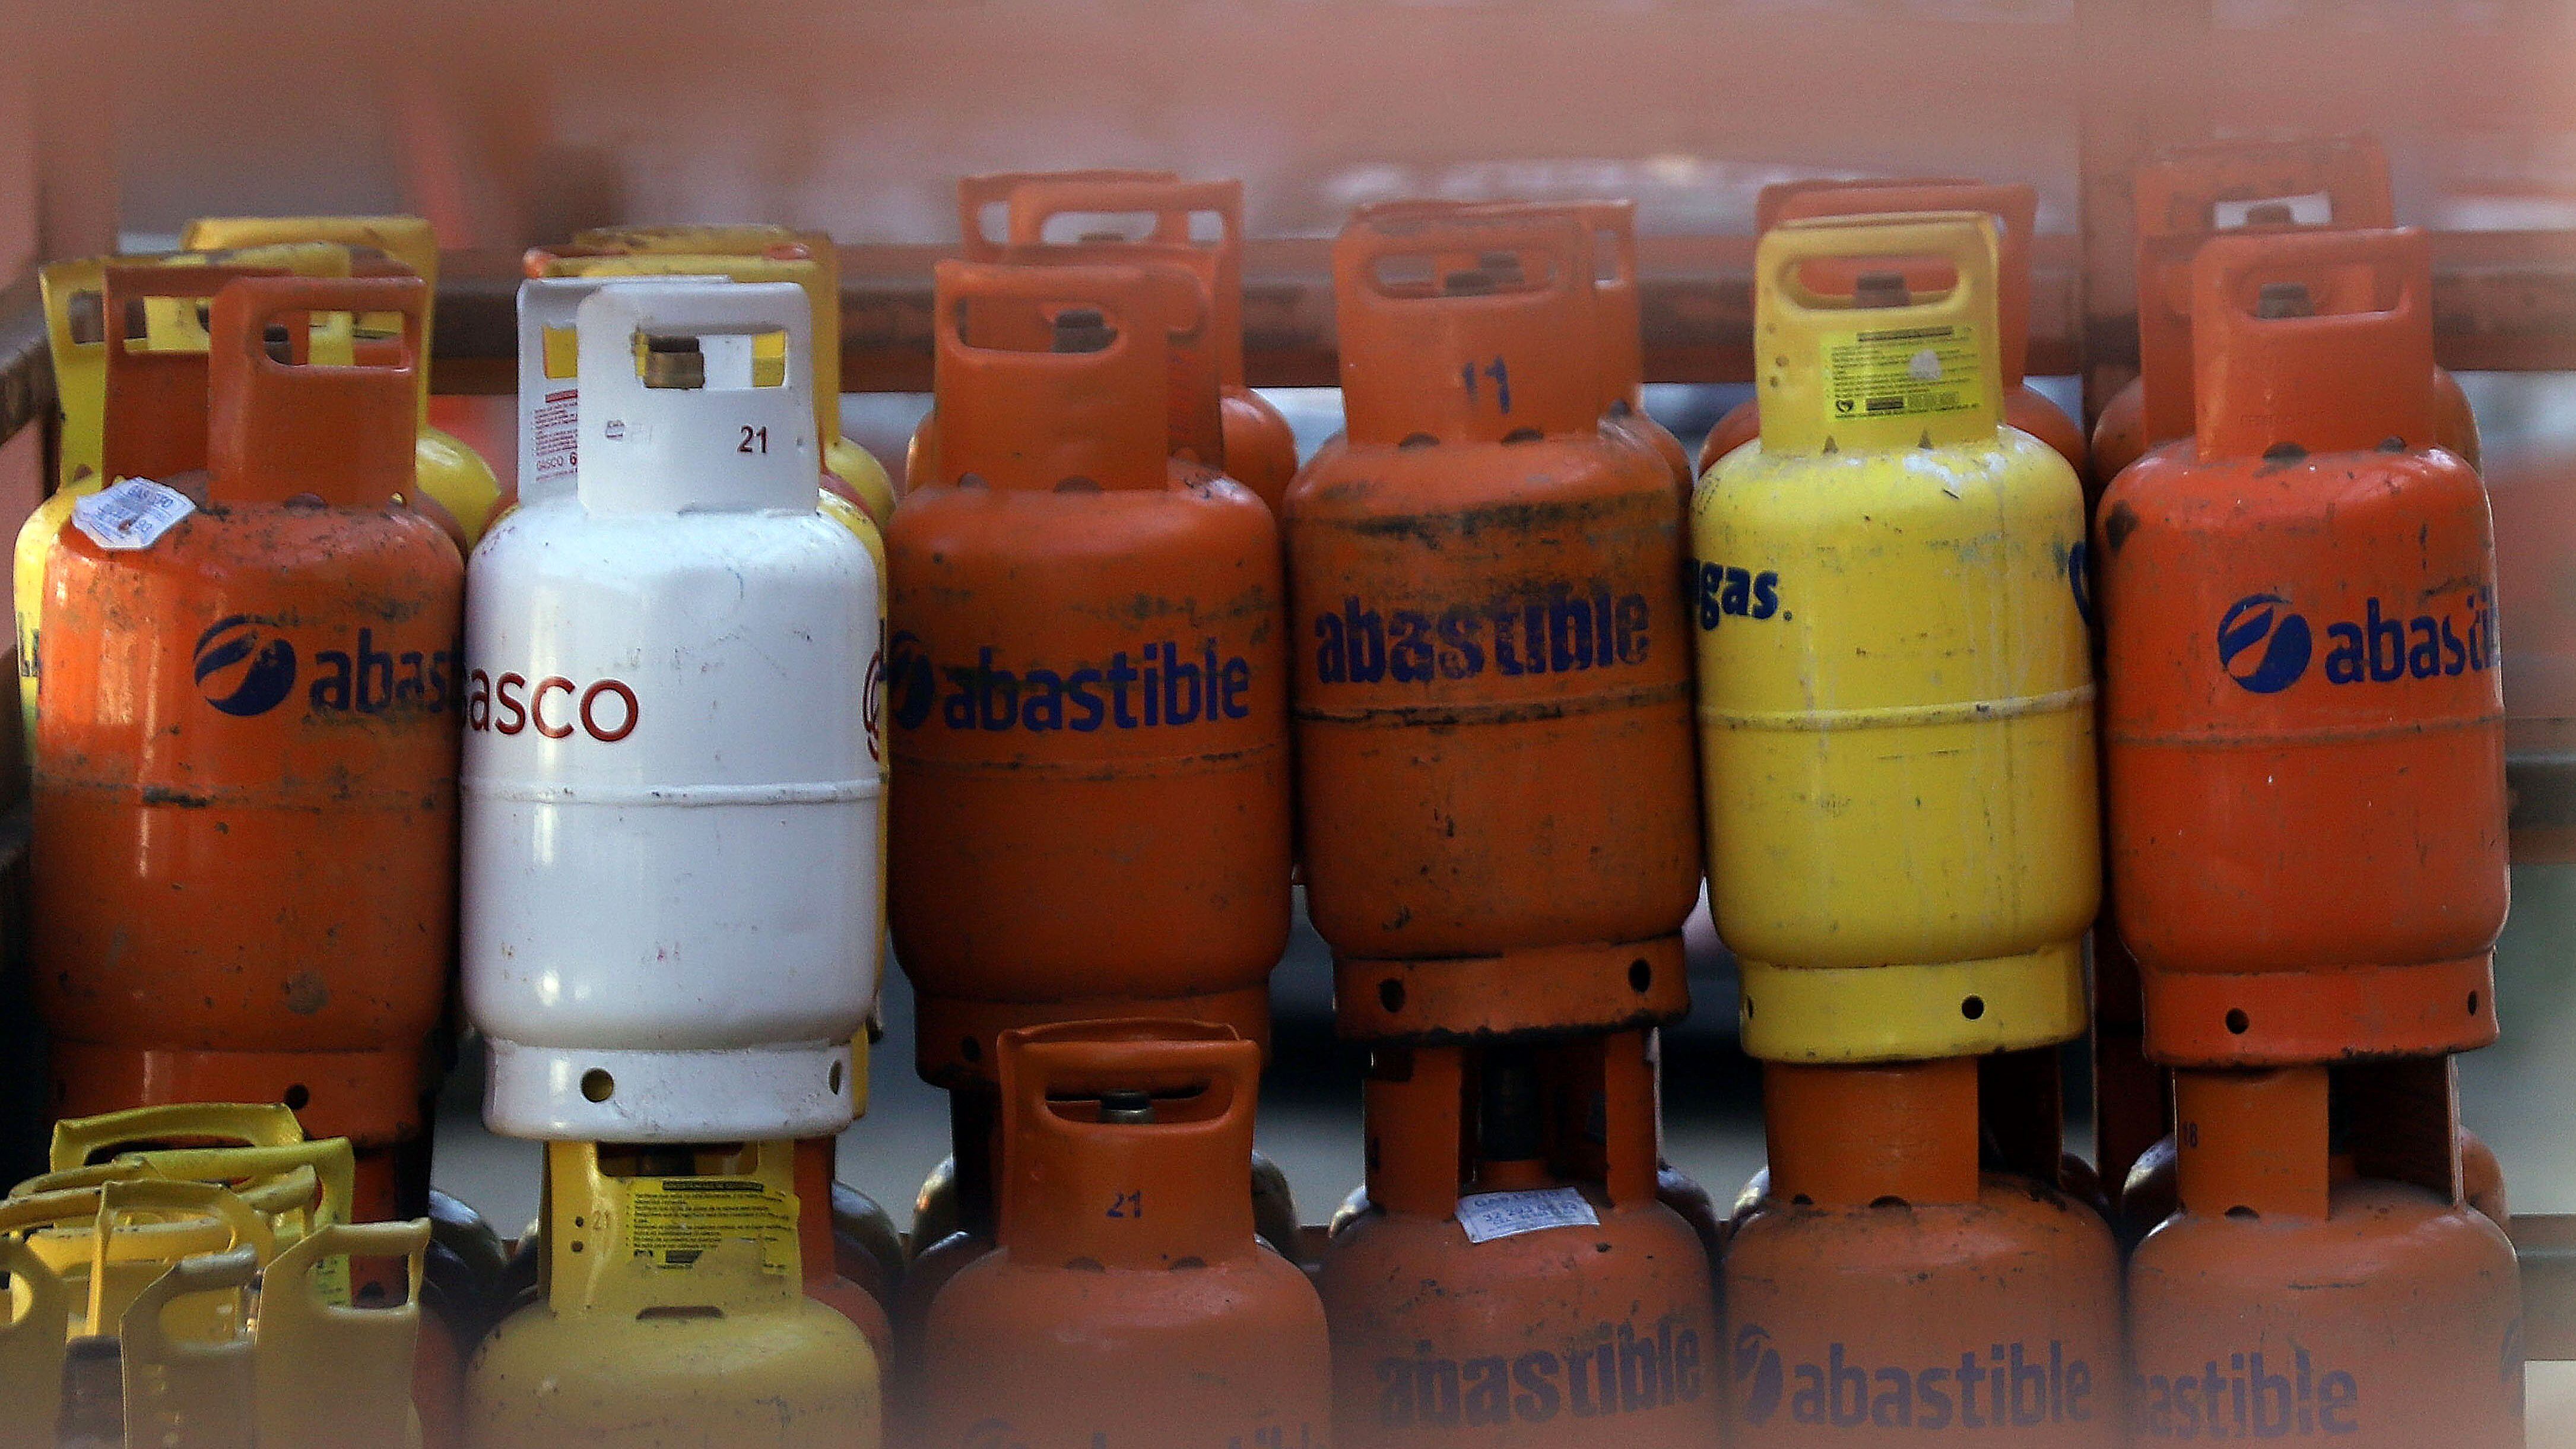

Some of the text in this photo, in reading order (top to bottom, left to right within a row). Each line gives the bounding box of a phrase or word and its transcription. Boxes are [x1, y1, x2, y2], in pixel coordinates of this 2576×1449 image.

[738, 424, 768, 454] 21
[1314, 581, 1650, 683] abastible
[943, 638, 1250, 732] abastible
[1106, 1190, 1142, 1218] 21
[1791, 1340, 2092, 1431] abastible
